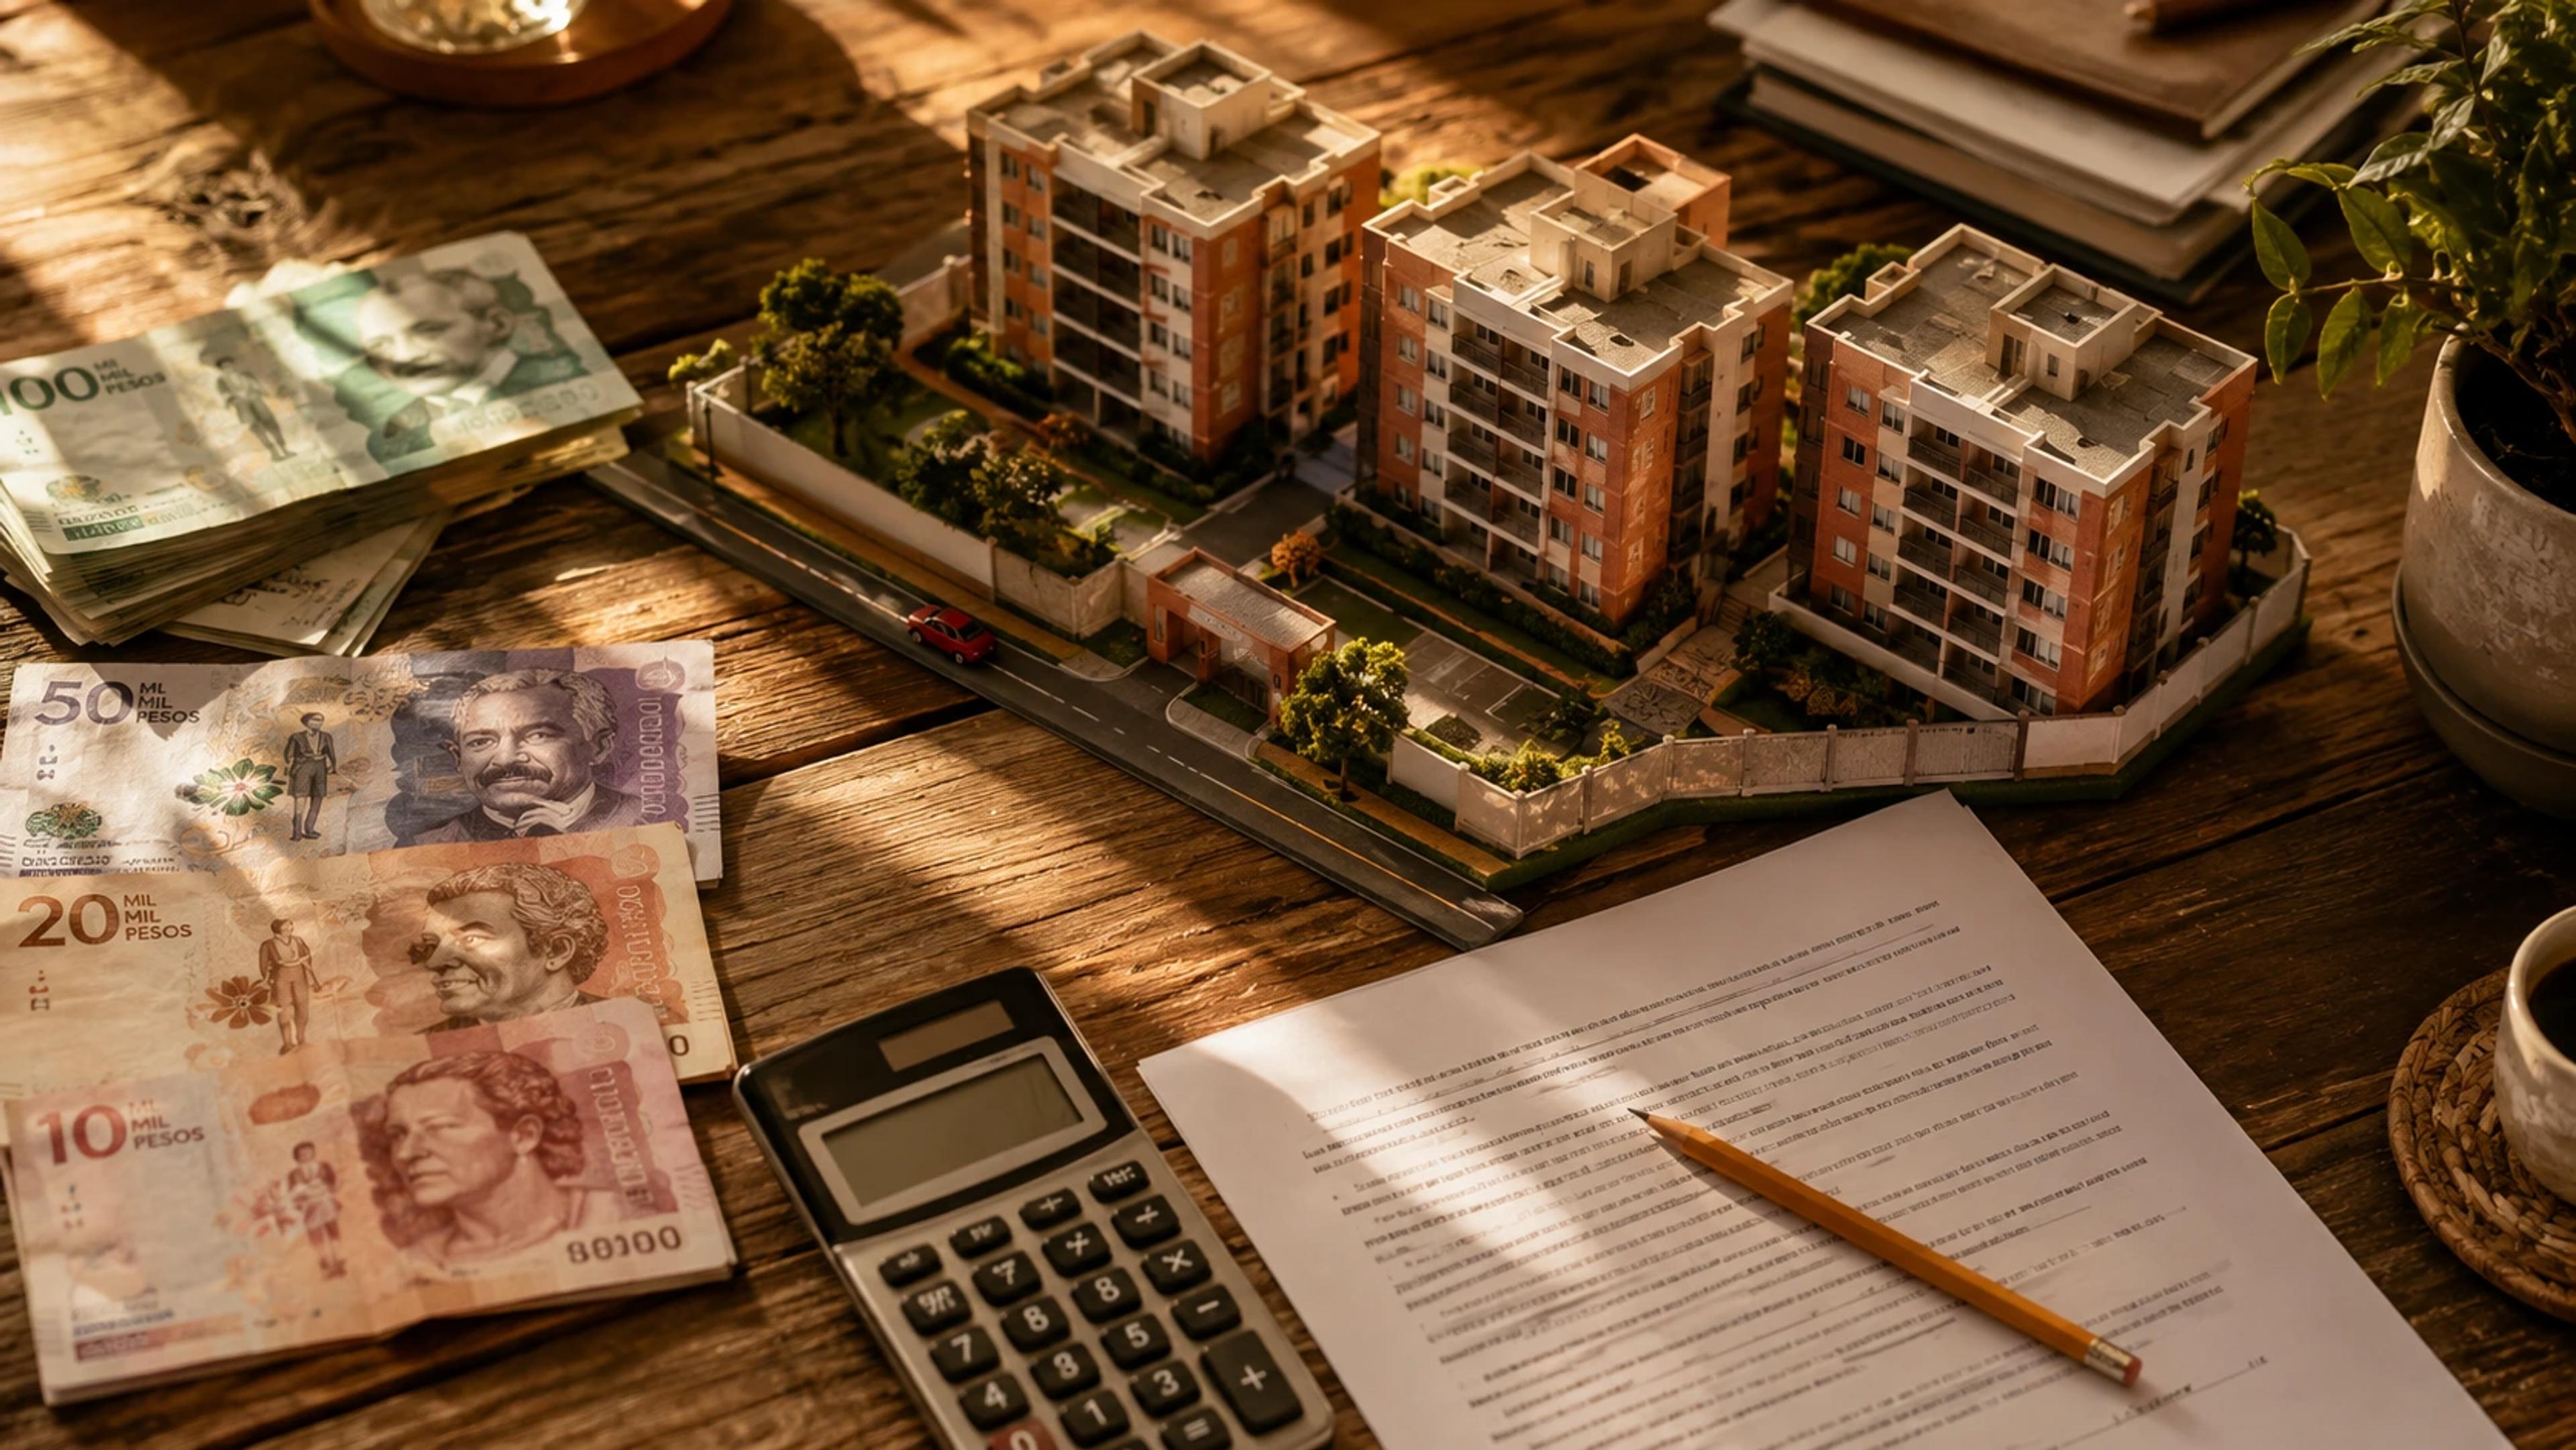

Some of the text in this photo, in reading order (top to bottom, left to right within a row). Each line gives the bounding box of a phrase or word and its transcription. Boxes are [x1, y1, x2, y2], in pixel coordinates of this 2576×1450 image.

[105, 371, 166, 395] PESOS
[34, 681, 133, 725] 50
[138, 696, 173, 709] MIL
[136, 711, 201, 724] PESOS
[123, 894, 156, 907] MIL
[18, 894, 120, 947] 20
[124, 910, 161, 924] MIL
[125, 924, 193, 941] PESOS
[37, 1104, 127, 1166] 10
[131, 1115, 170, 1133] MIL
[134, 1127, 205, 1150] PESOS
[1094, 1277, 1120, 1302] 8
[1023, 1305, 1049, 1332] 8
[951, 1333, 972, 1363] 7
[1125, 1322, 1149, 1349] 5
[984, 1381, 1008, 1408] 4
[1153, 1369, 1179, 1396] 3
[1084, 1398, 1106, 1426] 1
